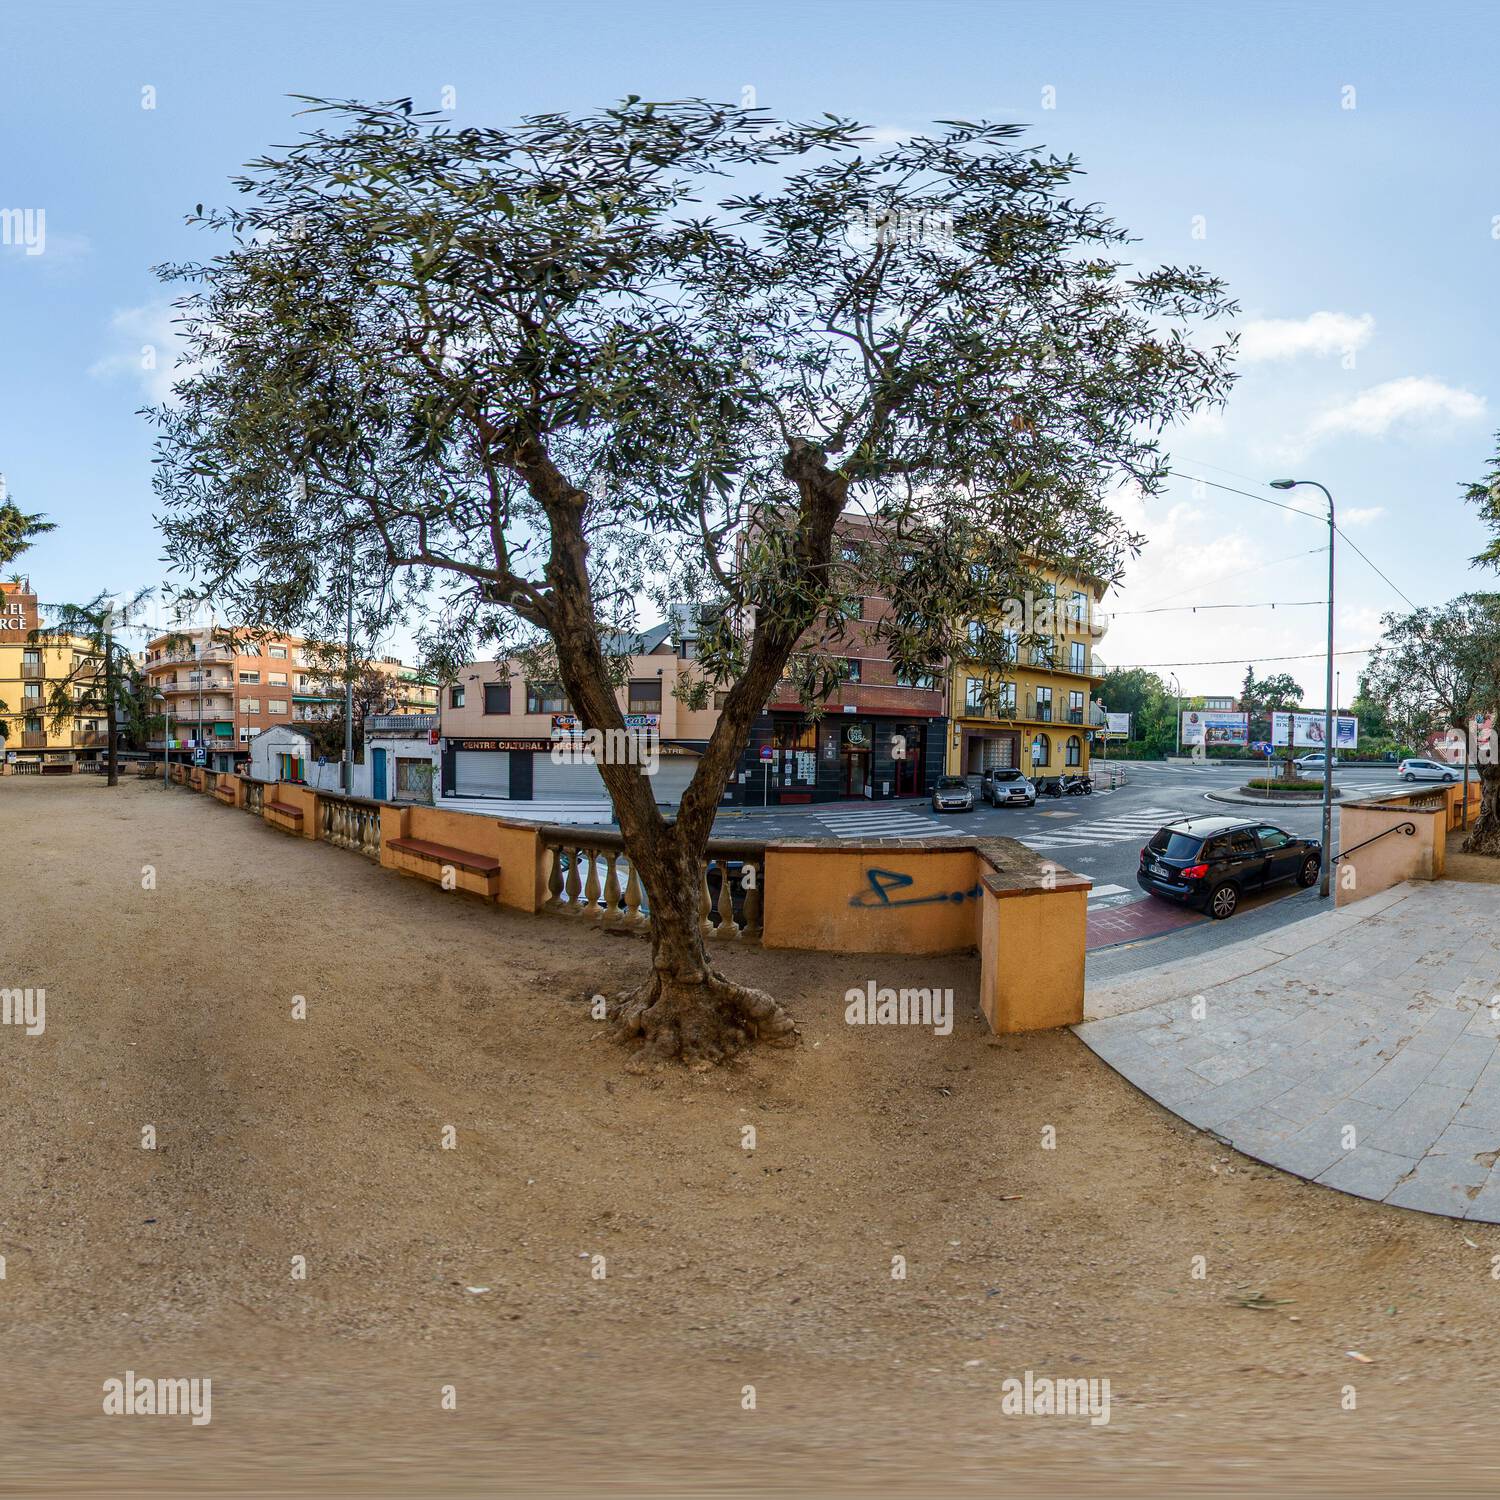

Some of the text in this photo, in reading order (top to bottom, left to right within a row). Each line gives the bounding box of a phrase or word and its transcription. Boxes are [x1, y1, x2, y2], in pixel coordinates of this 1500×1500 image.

[462, 741, 496, 750] CENTRE
[498, 741, 543, 750] CULTURAL
[197, 749, 204, 759] P
